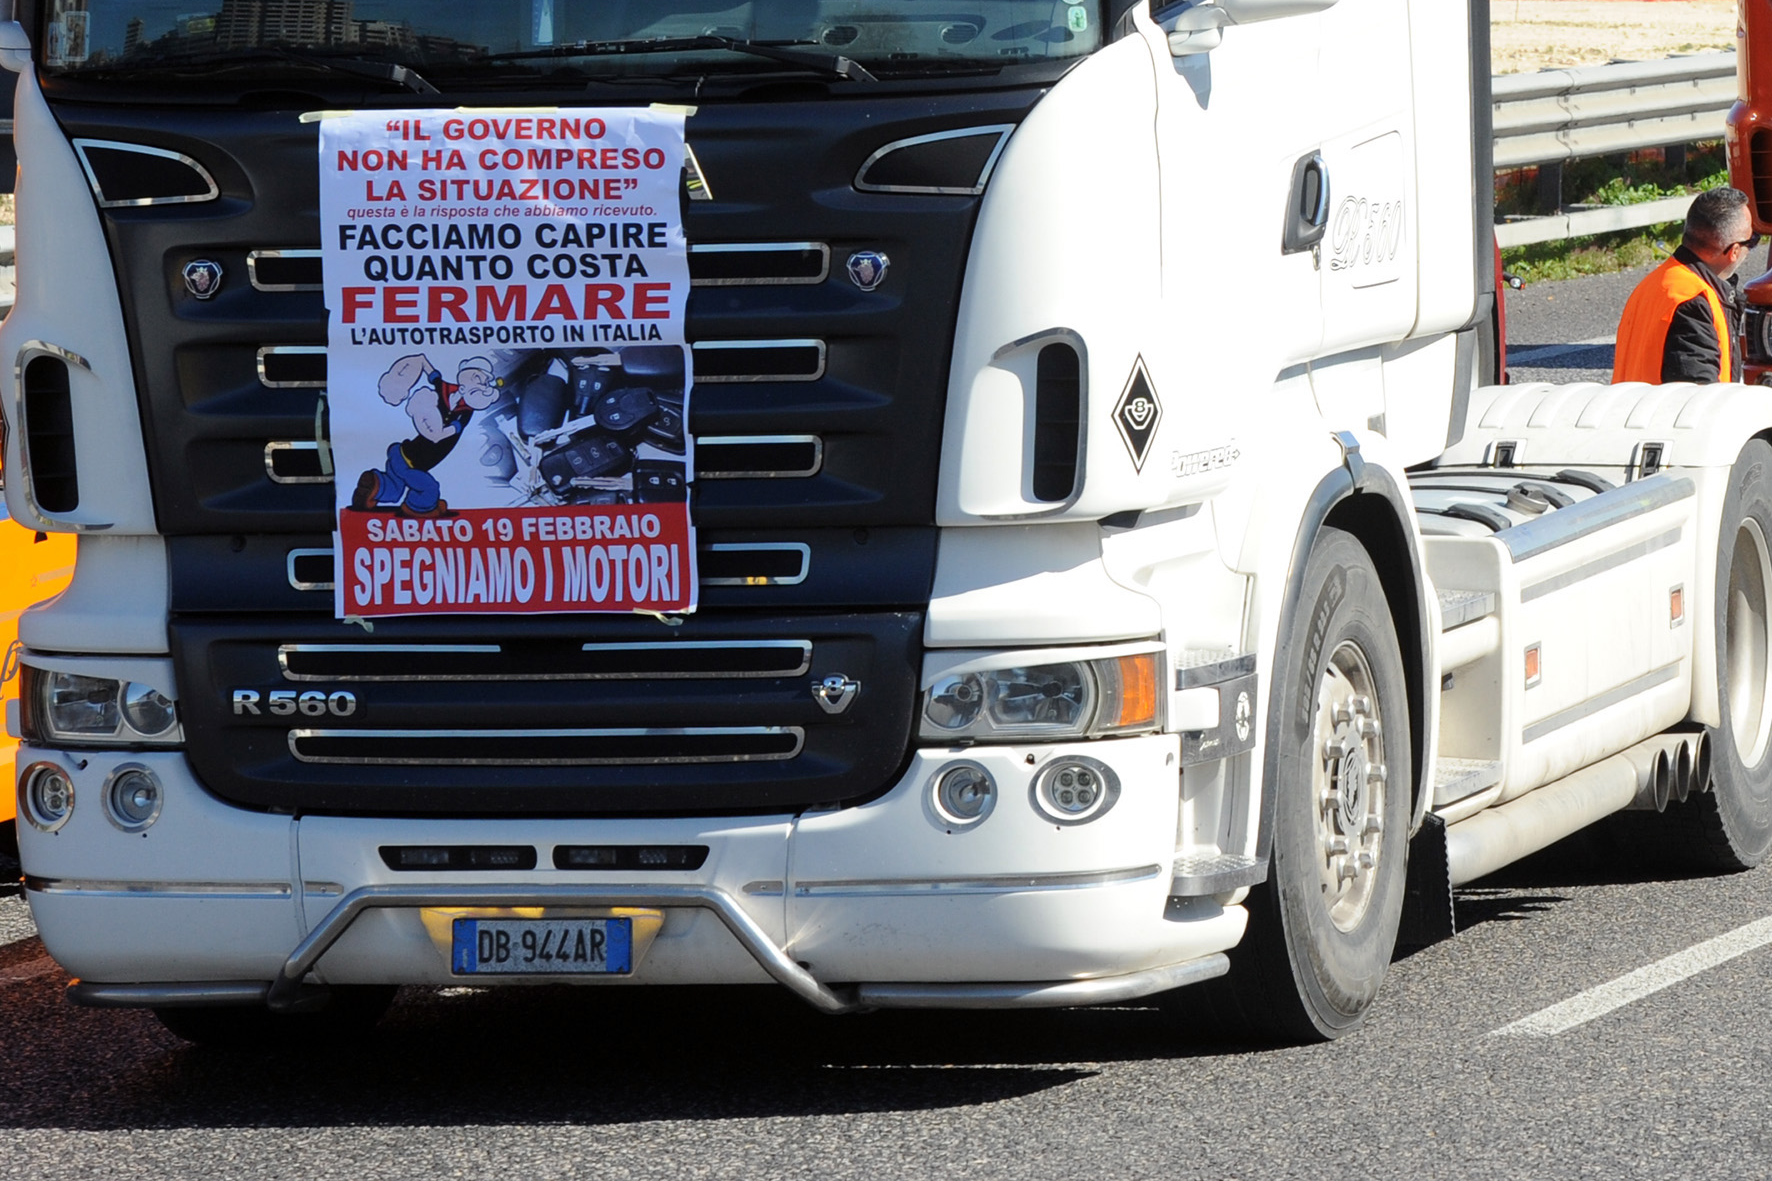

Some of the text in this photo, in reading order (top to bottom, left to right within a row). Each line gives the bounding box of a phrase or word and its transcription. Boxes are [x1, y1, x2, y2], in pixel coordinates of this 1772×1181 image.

[443, 118, 606, 140] GOVERNO
[338, 148, 665, 171] NON HA COMPRESO
[366, 179, 407, 201] LA
[347, 203, 657, 220] questa è la risposta che abbiamo ricevuto.
[339, 222, 667, 250] FACCIAMO CAPIRE
[364, 253, 648, 282] QUANTO COSTA
[341, 282, 671, 323] FERMARE
[563, 324, 585, 342] IN
[592, 323, 662, 342] ITALIA
[367, 514, 661, 542] SABATO 19 FEBBRAIO
[353, 543, 679, 606] SPEGNIAMO I MOTORI
[232, 689, 357, 717] R 560
[478, 928, 606, 963] DB 944AR
